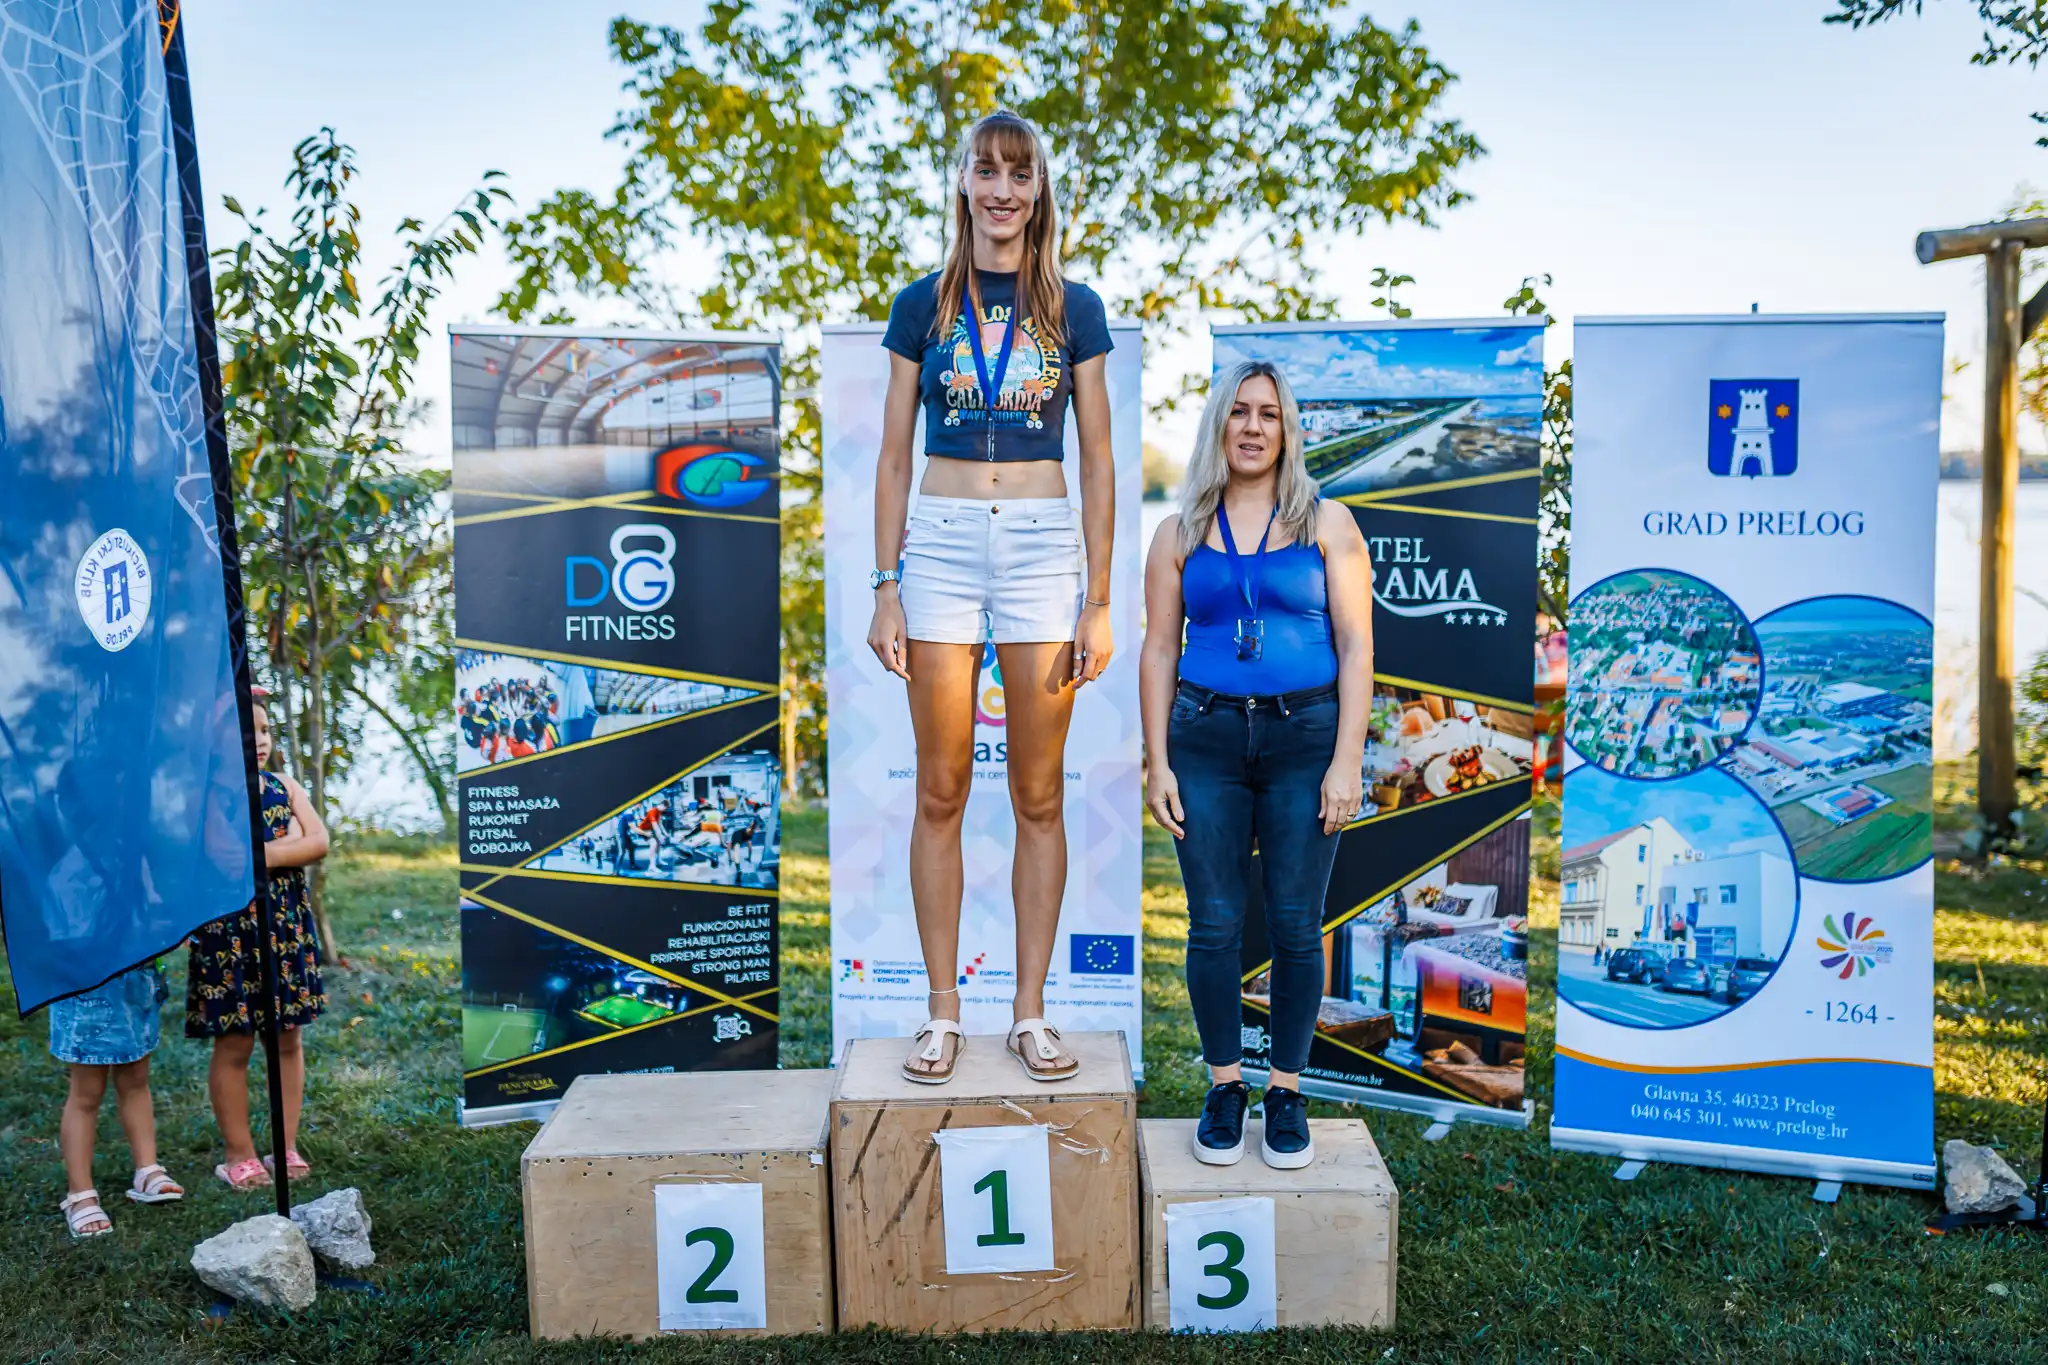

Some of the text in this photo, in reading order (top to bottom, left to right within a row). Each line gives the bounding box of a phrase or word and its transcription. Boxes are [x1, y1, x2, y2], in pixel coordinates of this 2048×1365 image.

[946, 387, 1041, 411] CALIORNIA
[1643, 509, 1865, 536] GRAD PRELOG
[566, 615, 676, 641] FITNESS
[468, 786, 519, 799] FITNESS
[468, 796, 560, 813] SPA & MASAŽA
[469, 813, 529, 827] RUKOMET
[469, 828, 517, 841] FUTSAL
[469, 841, 532, 855] ODBOJKA
[728, 904, 770, 918] BE FITT
[683, 918, 770, 934] FUNKCIONALNI
[668, 932, 770, 949] REHABILITACIJSKI
[650, 944, 770, 965] PRIPREME SPORTAŠA
[692, 957, 770, 974] STRONG MAN
[725, 971, 770, 985] PILATES
[1825, 1001, 1878, 1024] 1264
[1644, 1083, 1699, 1103] Glavna
[1732, 1092, 1779, 1111] 40323
[1784, 1096, 1836, 1119] Prelog
[1631, 1103, 1660, 1120] 040
[1663, 1107, 1691, 1123] 645
[1732, 1115, 1849, 1140] www.prelog.hr
[973, 1169, 1025, 1246] 1
[684, 1226, 739, 1303] 2
[1197, 1231, 1249, 1310] 3
